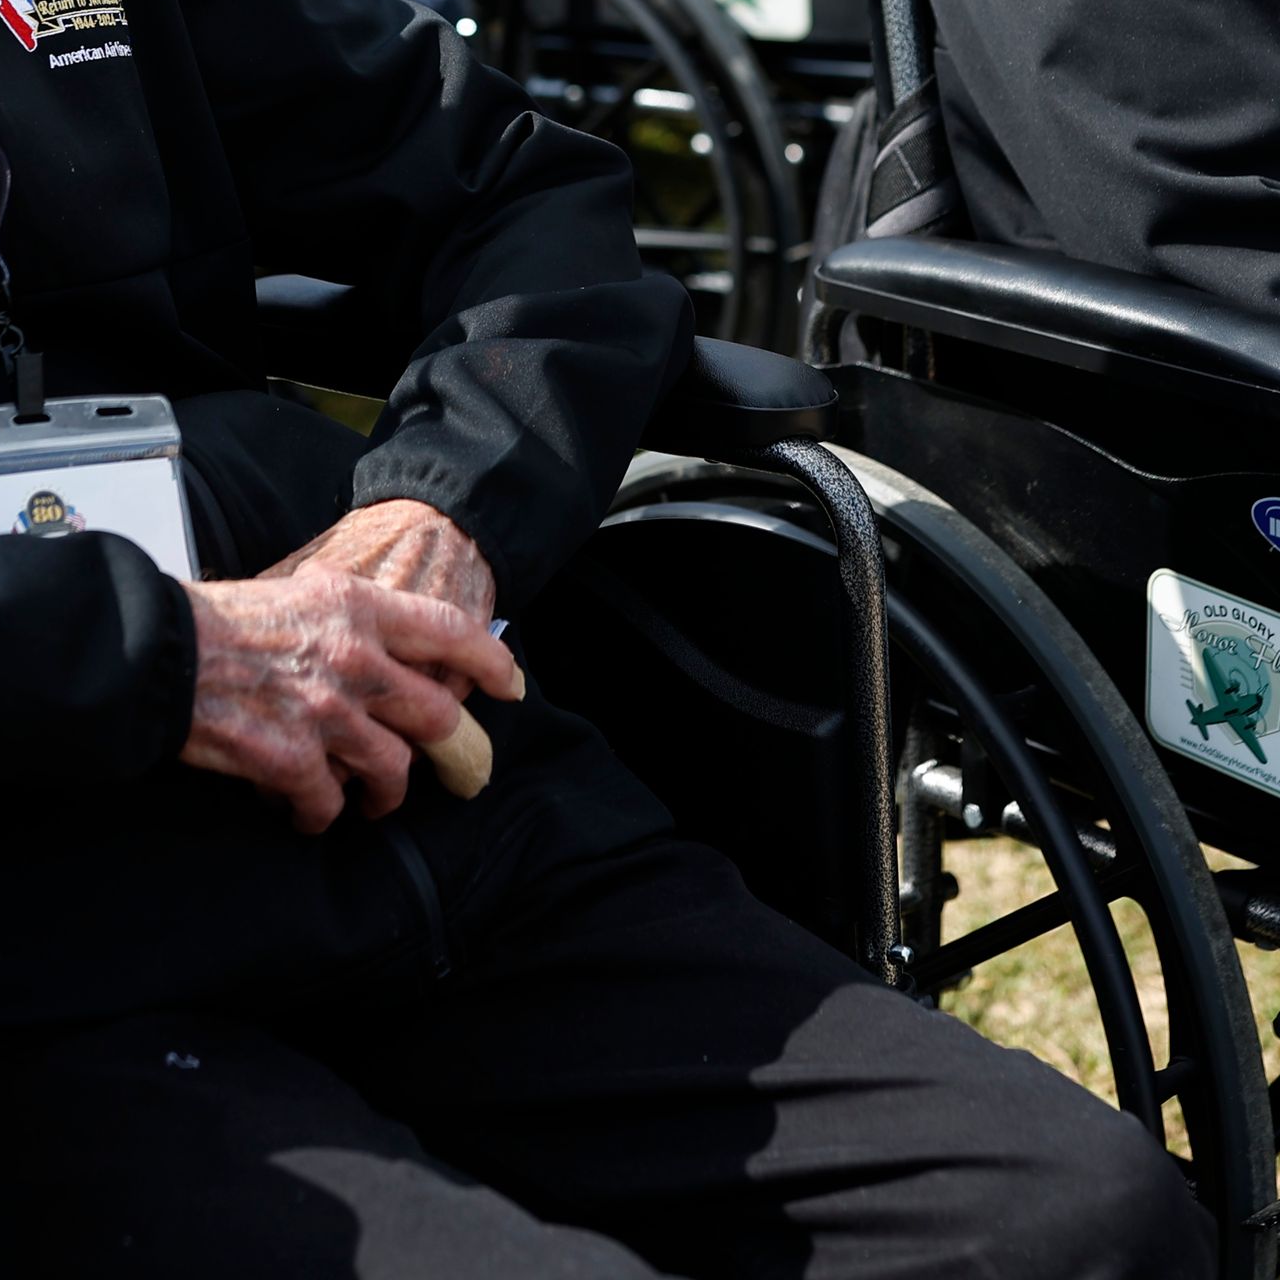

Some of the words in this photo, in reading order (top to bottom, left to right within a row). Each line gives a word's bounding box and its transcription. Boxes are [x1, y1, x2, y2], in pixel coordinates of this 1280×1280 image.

[49, 44, 106, 69] American
[32, 504, 64, 524] 80
[1159, 607, 1239, 656] Honor
[1203, 604, 1228, 619] OLD
[1232, 607, 1276, 640] GLORY
